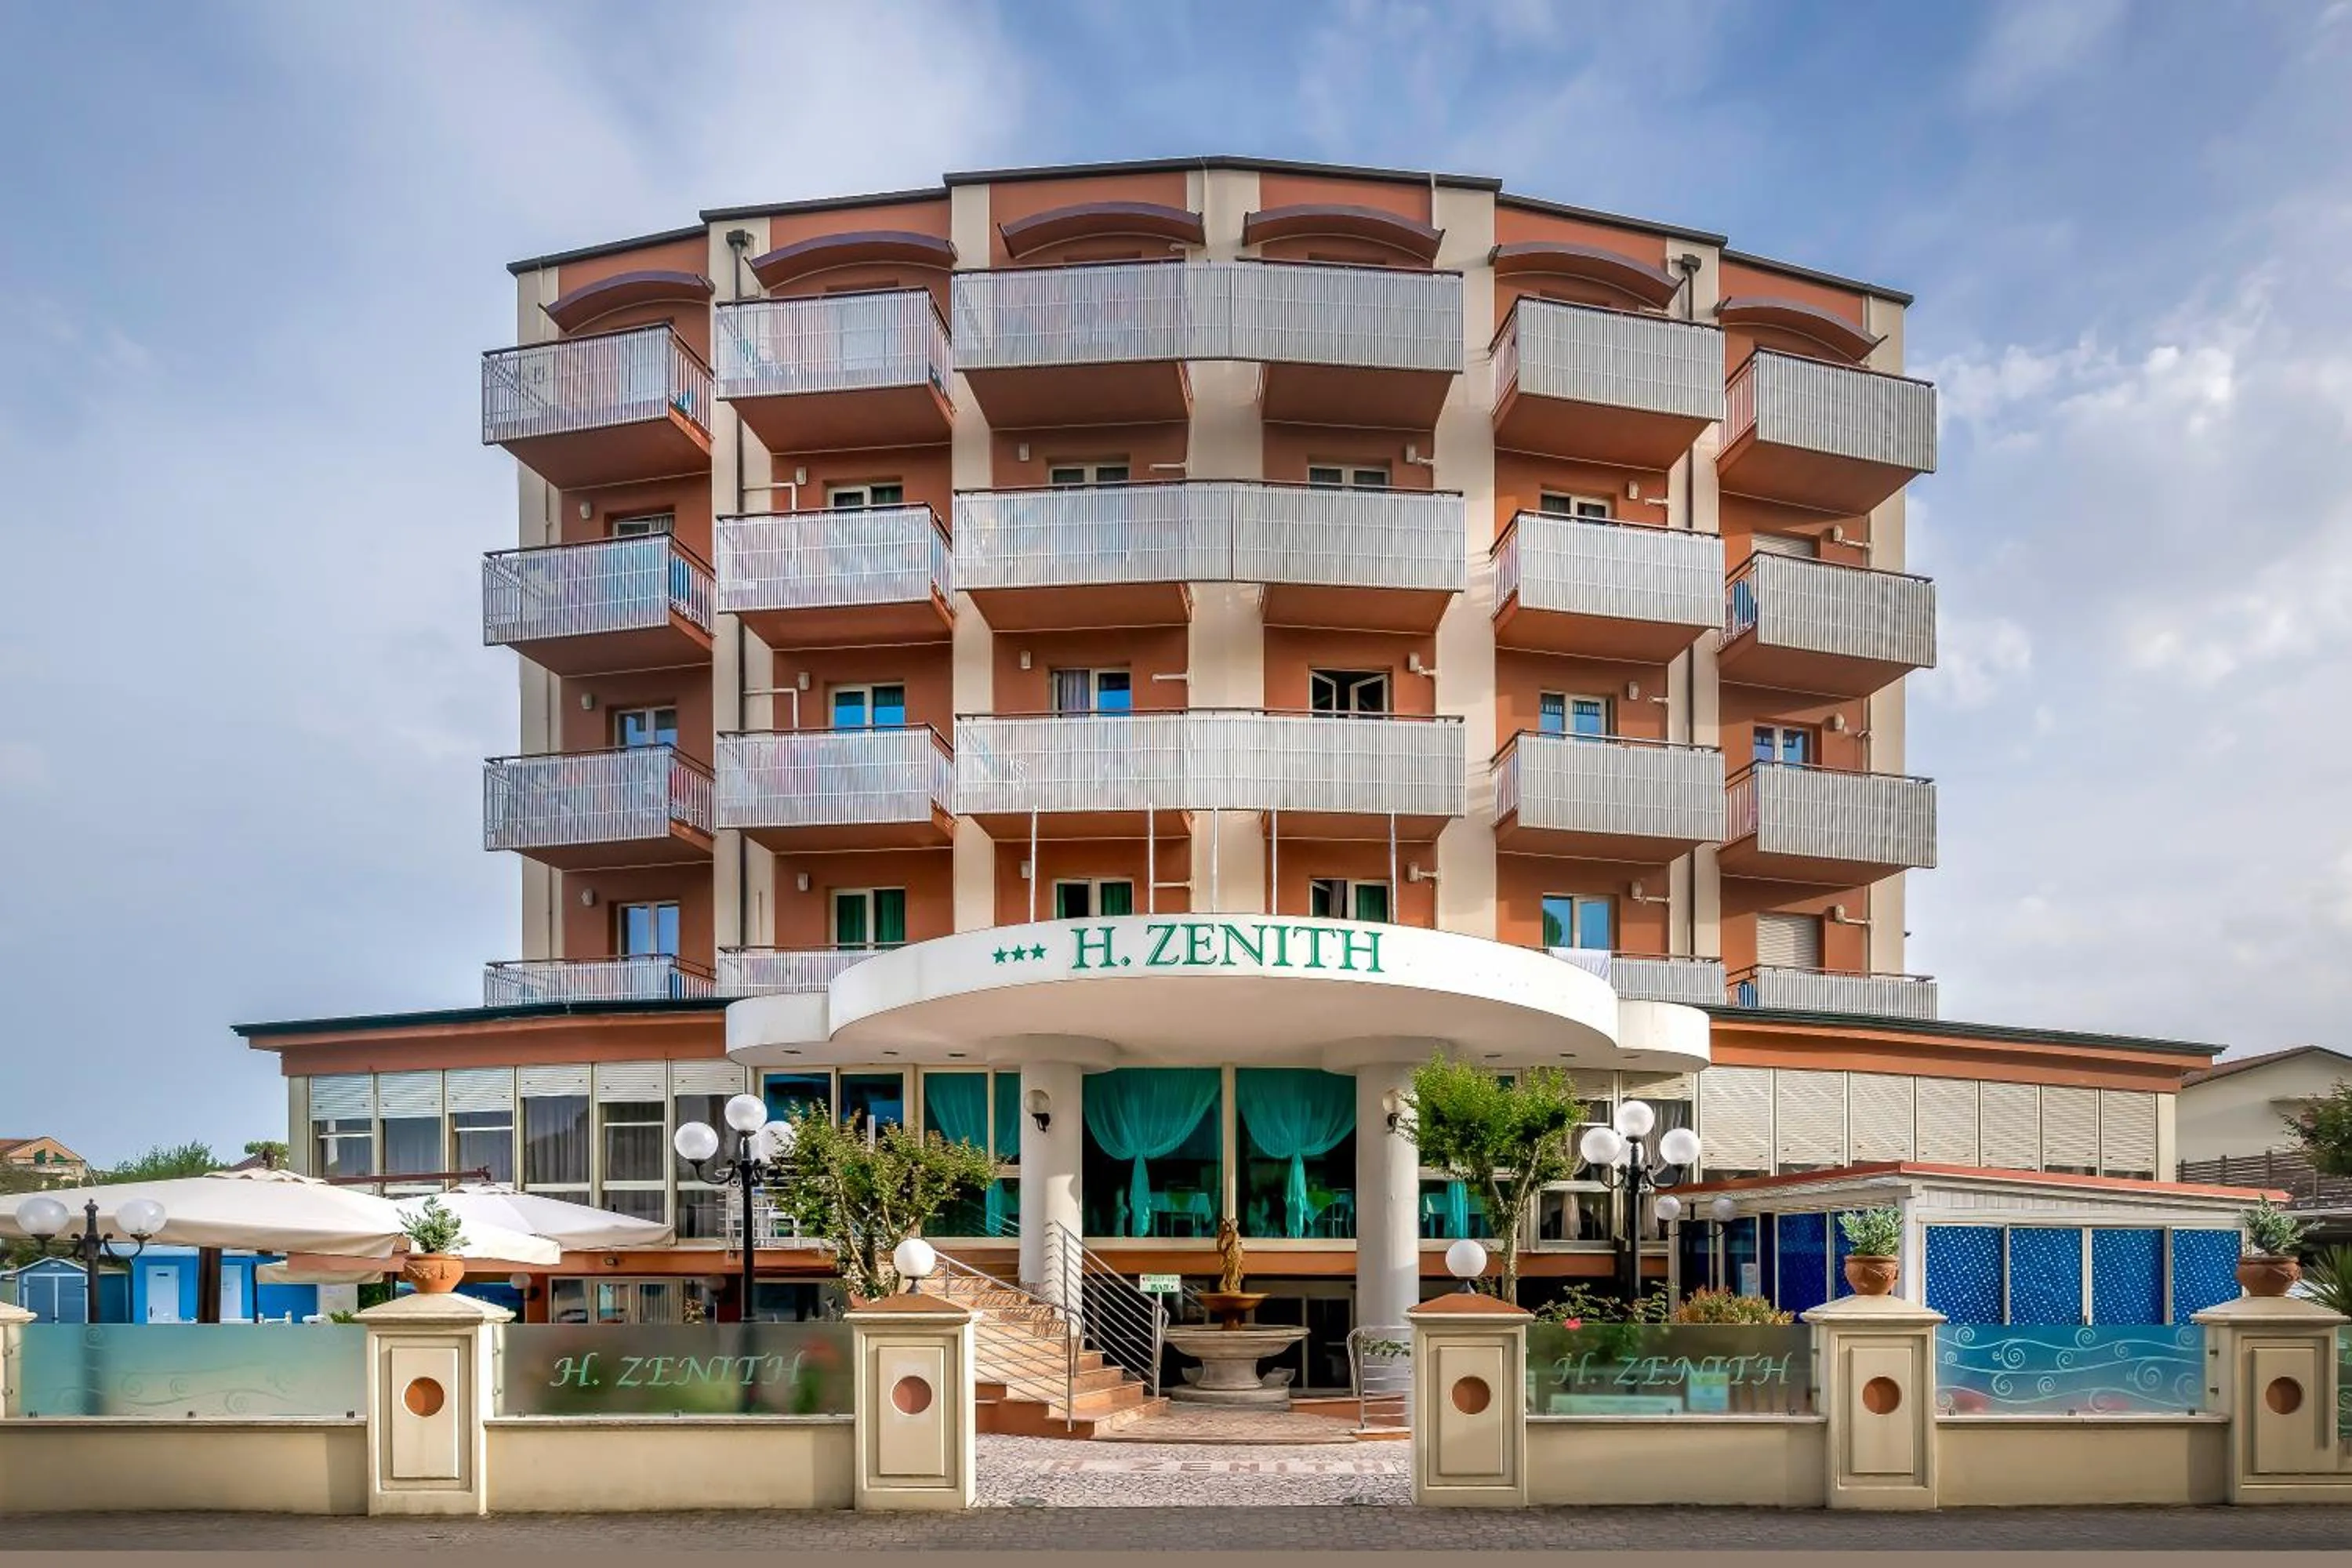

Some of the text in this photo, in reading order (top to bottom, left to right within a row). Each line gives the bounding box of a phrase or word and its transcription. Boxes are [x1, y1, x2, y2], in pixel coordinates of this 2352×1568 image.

[1070, 923, 1385, 973] H. ZENITH
[550, 1350, 807, 1387] H. ZENITH
[1549, 1351, 1793, 1386] H. ZENITH
